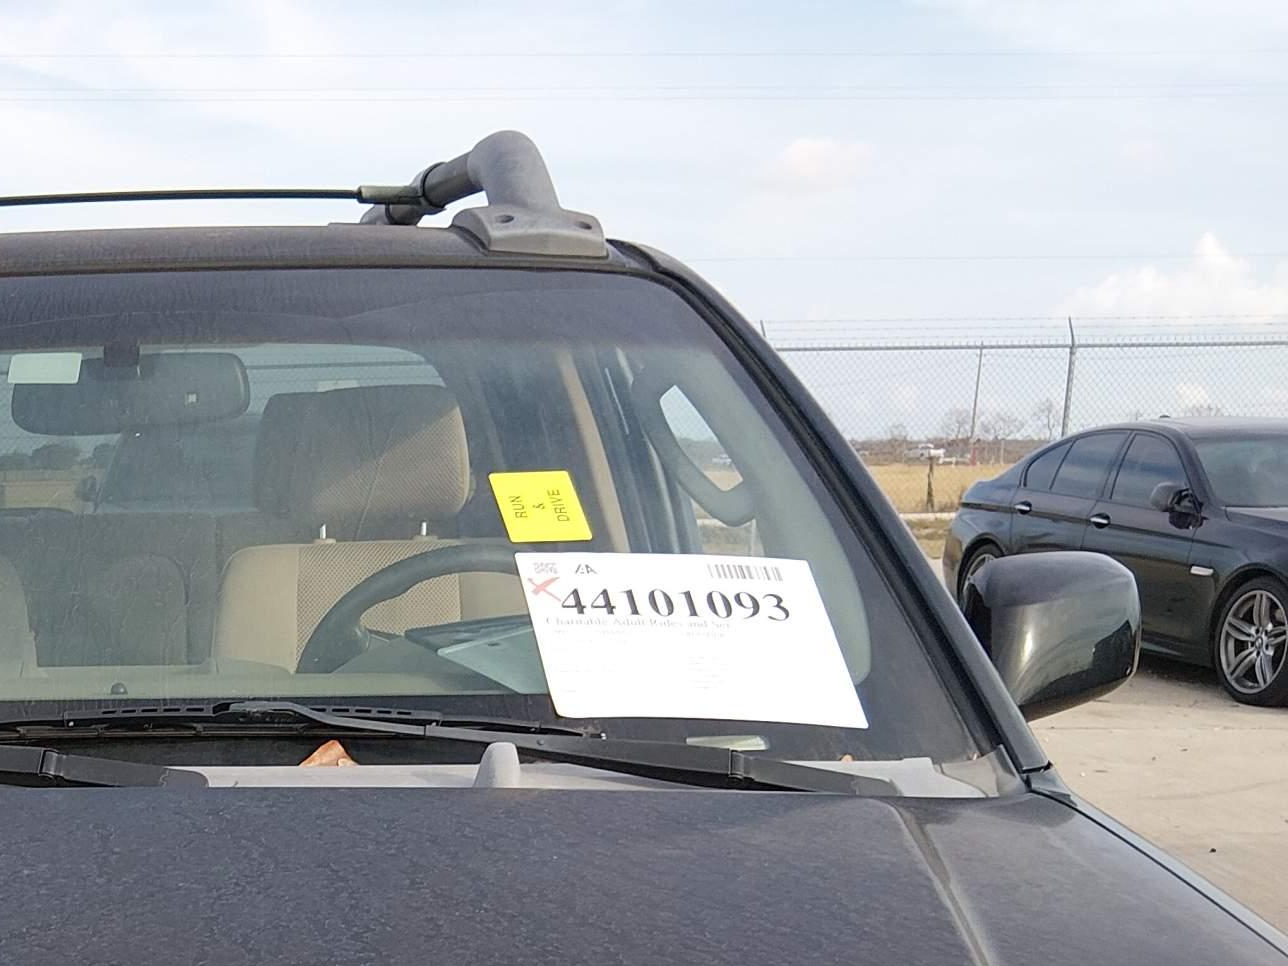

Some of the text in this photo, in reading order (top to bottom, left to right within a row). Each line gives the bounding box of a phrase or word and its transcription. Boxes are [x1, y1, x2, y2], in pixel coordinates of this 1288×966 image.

[508, 495, 528, 518] RUN
[532, 502, 545, 510] &
[547, 489, 570, 522] DRIVE
[561, 588, 790, 621] 44101093
